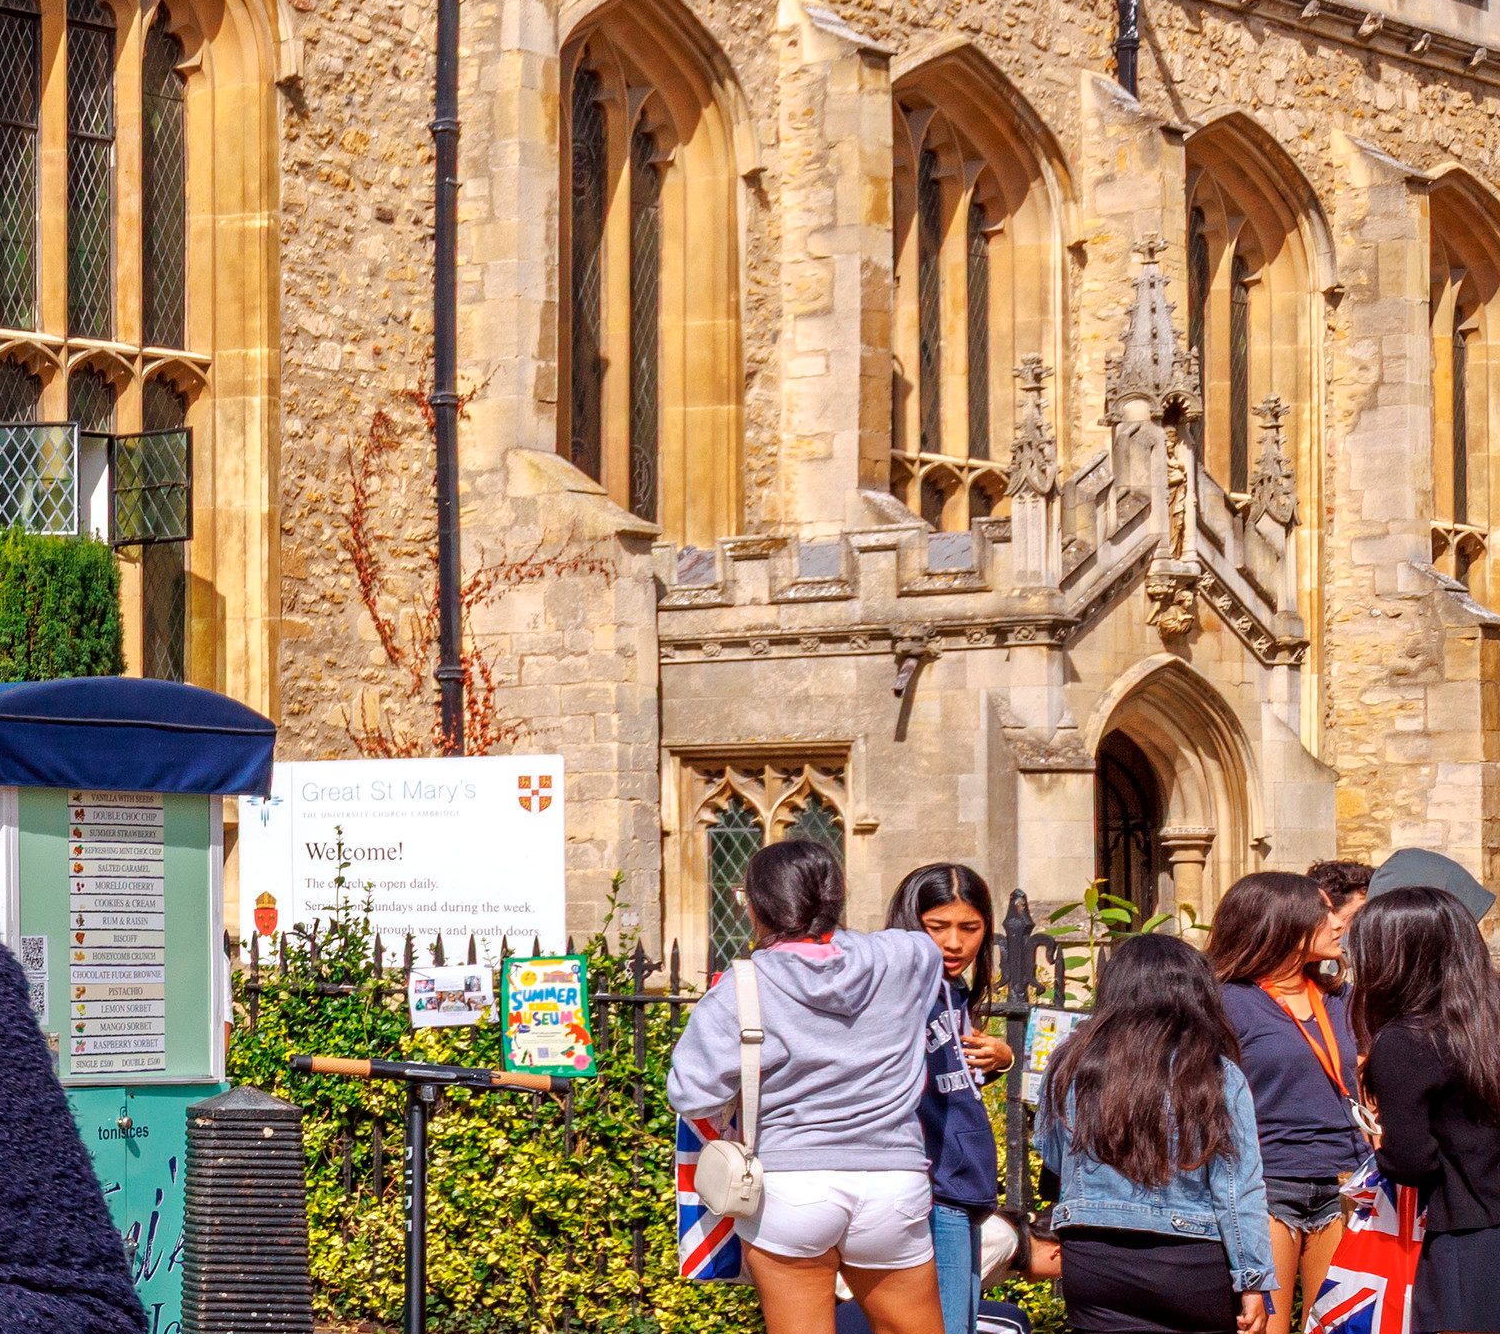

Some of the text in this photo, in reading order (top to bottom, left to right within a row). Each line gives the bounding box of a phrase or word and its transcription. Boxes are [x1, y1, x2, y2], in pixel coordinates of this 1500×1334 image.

[302, 779, 476, 803] Great St Mary's
[91, 794, 155, 803] VANILLA WITH SEEDS
[93, 811, 157, 821] DOUBLE CHOC CHIP
[321, 811, 369, 819] UNIVERSITY
[372, 810, 407, 818] CHURCH
[410, 809, 460, 817] CAMBRIDGE
[90, 829, 156, 838] SUMMER STRAWBERRY
[84, 847, 118, 855] REFRESHING
[119, 847, 133, 855] MINT
[133, 847, 148, 855] CHOC
[97, 864, 121, 872] SALTED
[95, 882, 154, 891] MORELLO CHERRY
[305, 878, 324, 888] The
[380, 880, 406, 891] open
[409, 878, 439, 891] daily.
[94, 899, 124, 907] COOKIES
[131, 899, 156, 907] CREAM
[416, 901, 437, 912] and
[441, 901, 478, 914] during
[481, 901, 499, 913] the
[503, 901, 535, 913] week.
[102, 916, 118, 925] RUM
[126, 916, 148, 925] RAISIN
[372, 923, 414, 937] through
[418, 925, 442, 935] west
[446, 924, 467, 935] and
[471, 924, 502, 936] south
[506, 924, 542, 937] doors.
[113, 934, 138, 943] BISCOFF
[92, 952, 156, 960] HONEYCOMB CRUNCH
[72, 969, 161, 979] CHOCOLATE FUDGE BROWNIE
[108, 987, 143, 996] PISTACHIO
[510, 987, 577, 1011] SUMMER
[101, 1004, 152, 1013] LEMON SORBET
[508, 1008, 586, 1027] MUSEUMS
[100, 1022, 152, 1031] MANGO SORBET
[93, 1039, 158, 1049] RASPBERRY SORBET
[76, 1060, 98, 1068] SINGLE
[121, 1058, 145, 1067] DOUBLE
